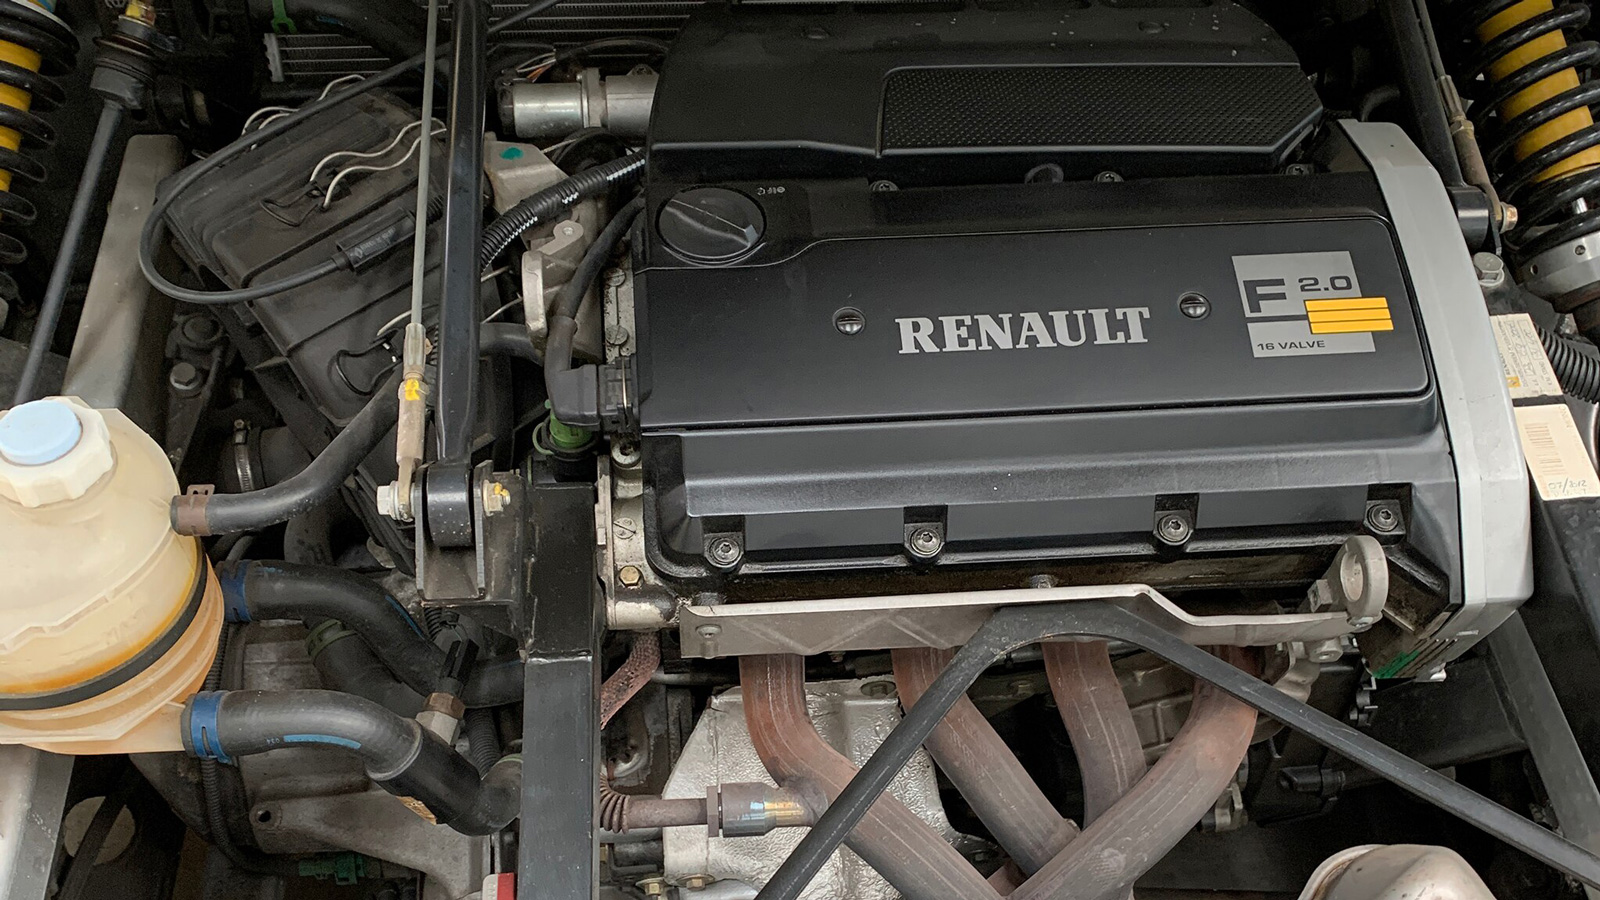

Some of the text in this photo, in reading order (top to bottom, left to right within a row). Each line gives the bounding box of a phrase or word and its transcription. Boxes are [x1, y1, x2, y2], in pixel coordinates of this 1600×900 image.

[1243, 275, 1352, 313] F 2.0
[895, 306, 1151, 354] RENAULT
[1257, 340, 1326, 351] 16 VALVE
